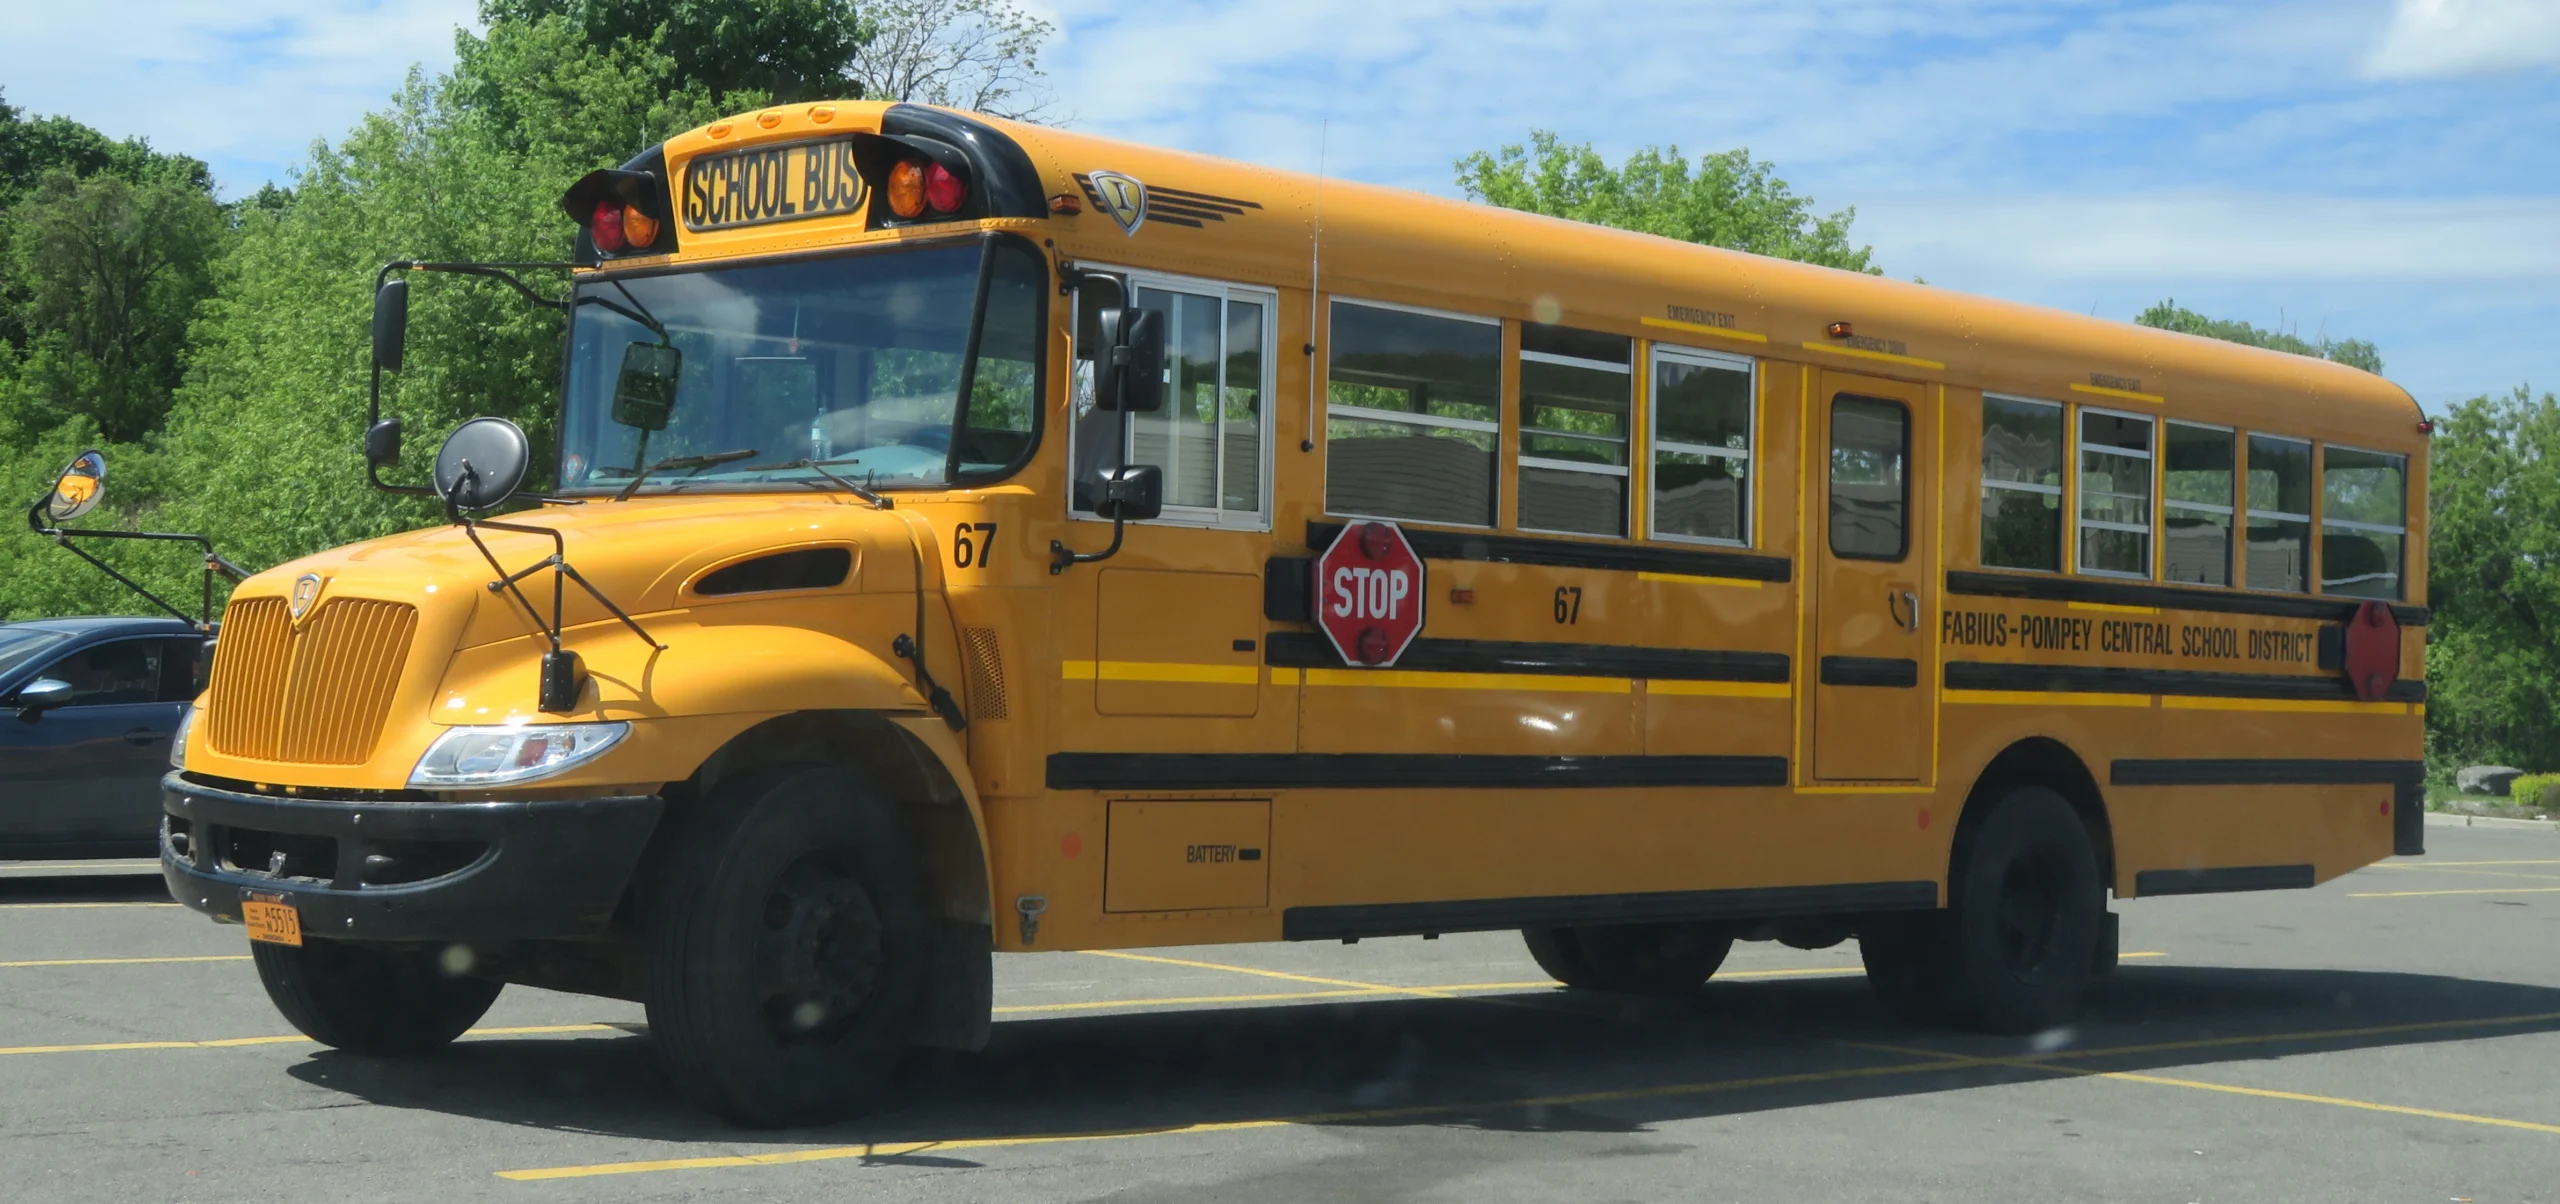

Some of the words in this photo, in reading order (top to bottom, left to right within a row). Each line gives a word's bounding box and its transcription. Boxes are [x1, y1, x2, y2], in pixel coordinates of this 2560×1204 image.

[691, 150, 795, 226] SCHOOL
[803, 142, 859, 213] BUS
[1667, 304, 1716, 327] EMERGENCY
[1718, 312, 1735, 329] EXIT
[954, 522, 997, 569] 67
[1334, 566, 1408, 620] STOP
[1554, 586, 1582, 625] 67
[1942, 610, 2093, 652] FABIUS-POMPEY
[2101, 619, 2173, 655] CENTRAL
[2181, 625, 2240, 659] SCHOOL
[2249, 629, 2313, 662] DISTRICT
[1187, 844, 1236, 864] BATTERY
